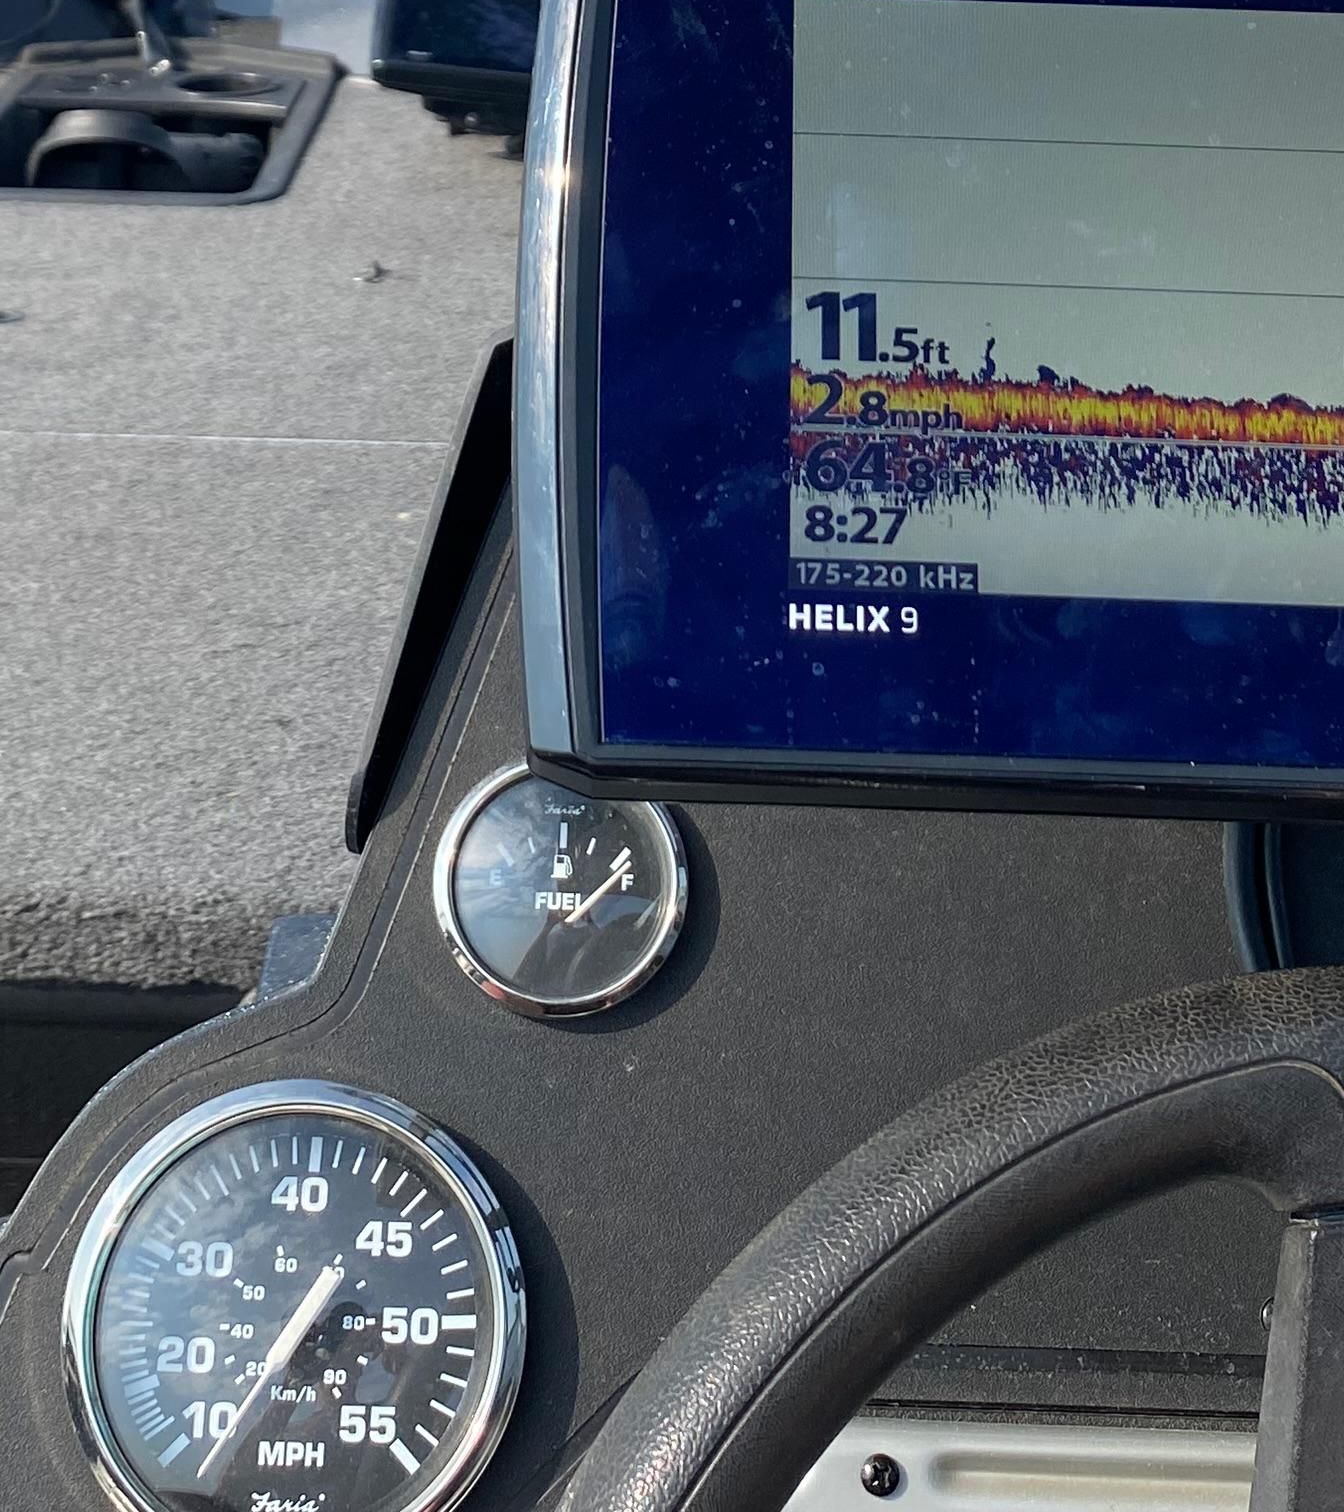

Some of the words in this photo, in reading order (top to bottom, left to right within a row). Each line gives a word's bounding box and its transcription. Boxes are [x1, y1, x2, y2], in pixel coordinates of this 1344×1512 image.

[804, 504, 908, 545] 8:27
[795, 561, 908, 587] 175-220
[919, 564, 975, 591] kHz
[788, 602, 891, 633] HELIX
[900, 606, 920, 634] 9
[489, 869, 502, 886] E
[620, 873, 635, 891] F
[271, 1176, 329, 1213] 40
[355, 1220, 414, 1258] 45
[175, 1241, 234, 1278] 30
[274, 1257, 298, 1273] 60
[242, 1285, 266, 1301] 50
[230, 1323, 255, 1339] 40
[342, 1315, 365, 1331] 80
[380, 1306, 440, 1345] 50
[156, 1336, 216, 1374] 20
[245, 1361, 267, 1377] 20
[323, 1368, 347, 1385] 90
[270, 1385, 317, 1403] Km/h
[182, 1399, 238, 1441] 10
[339, 1405, 398, 1444] 55
[257, 1440, 326, 1468] MPH
